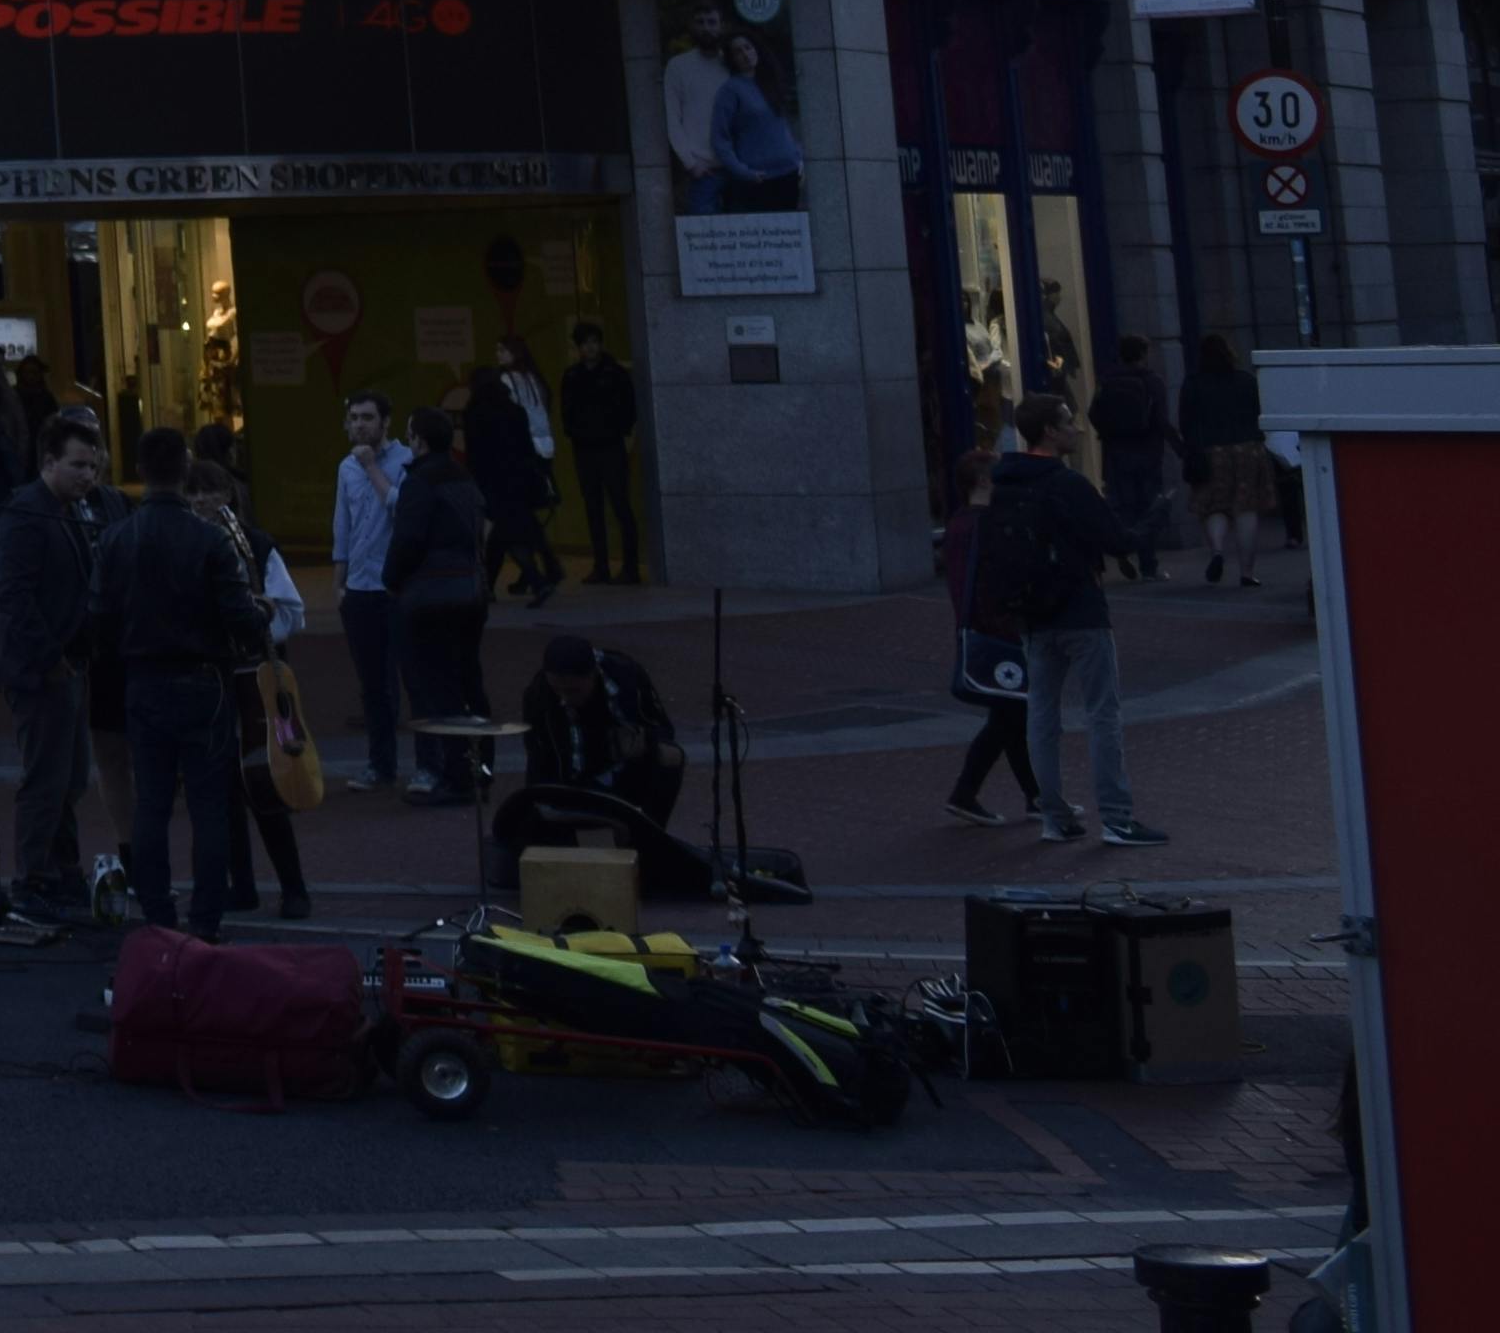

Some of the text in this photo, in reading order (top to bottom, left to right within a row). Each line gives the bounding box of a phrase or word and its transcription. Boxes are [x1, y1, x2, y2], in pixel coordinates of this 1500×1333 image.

[1253, 91, 1300, 128] 30
[1259, 132, 1298, 147] km/h
[126, 164, 259, 194] GREEN
[269, 161, 442, 192] SHOPPING
[448, 159, 553, 189] CENTRE
